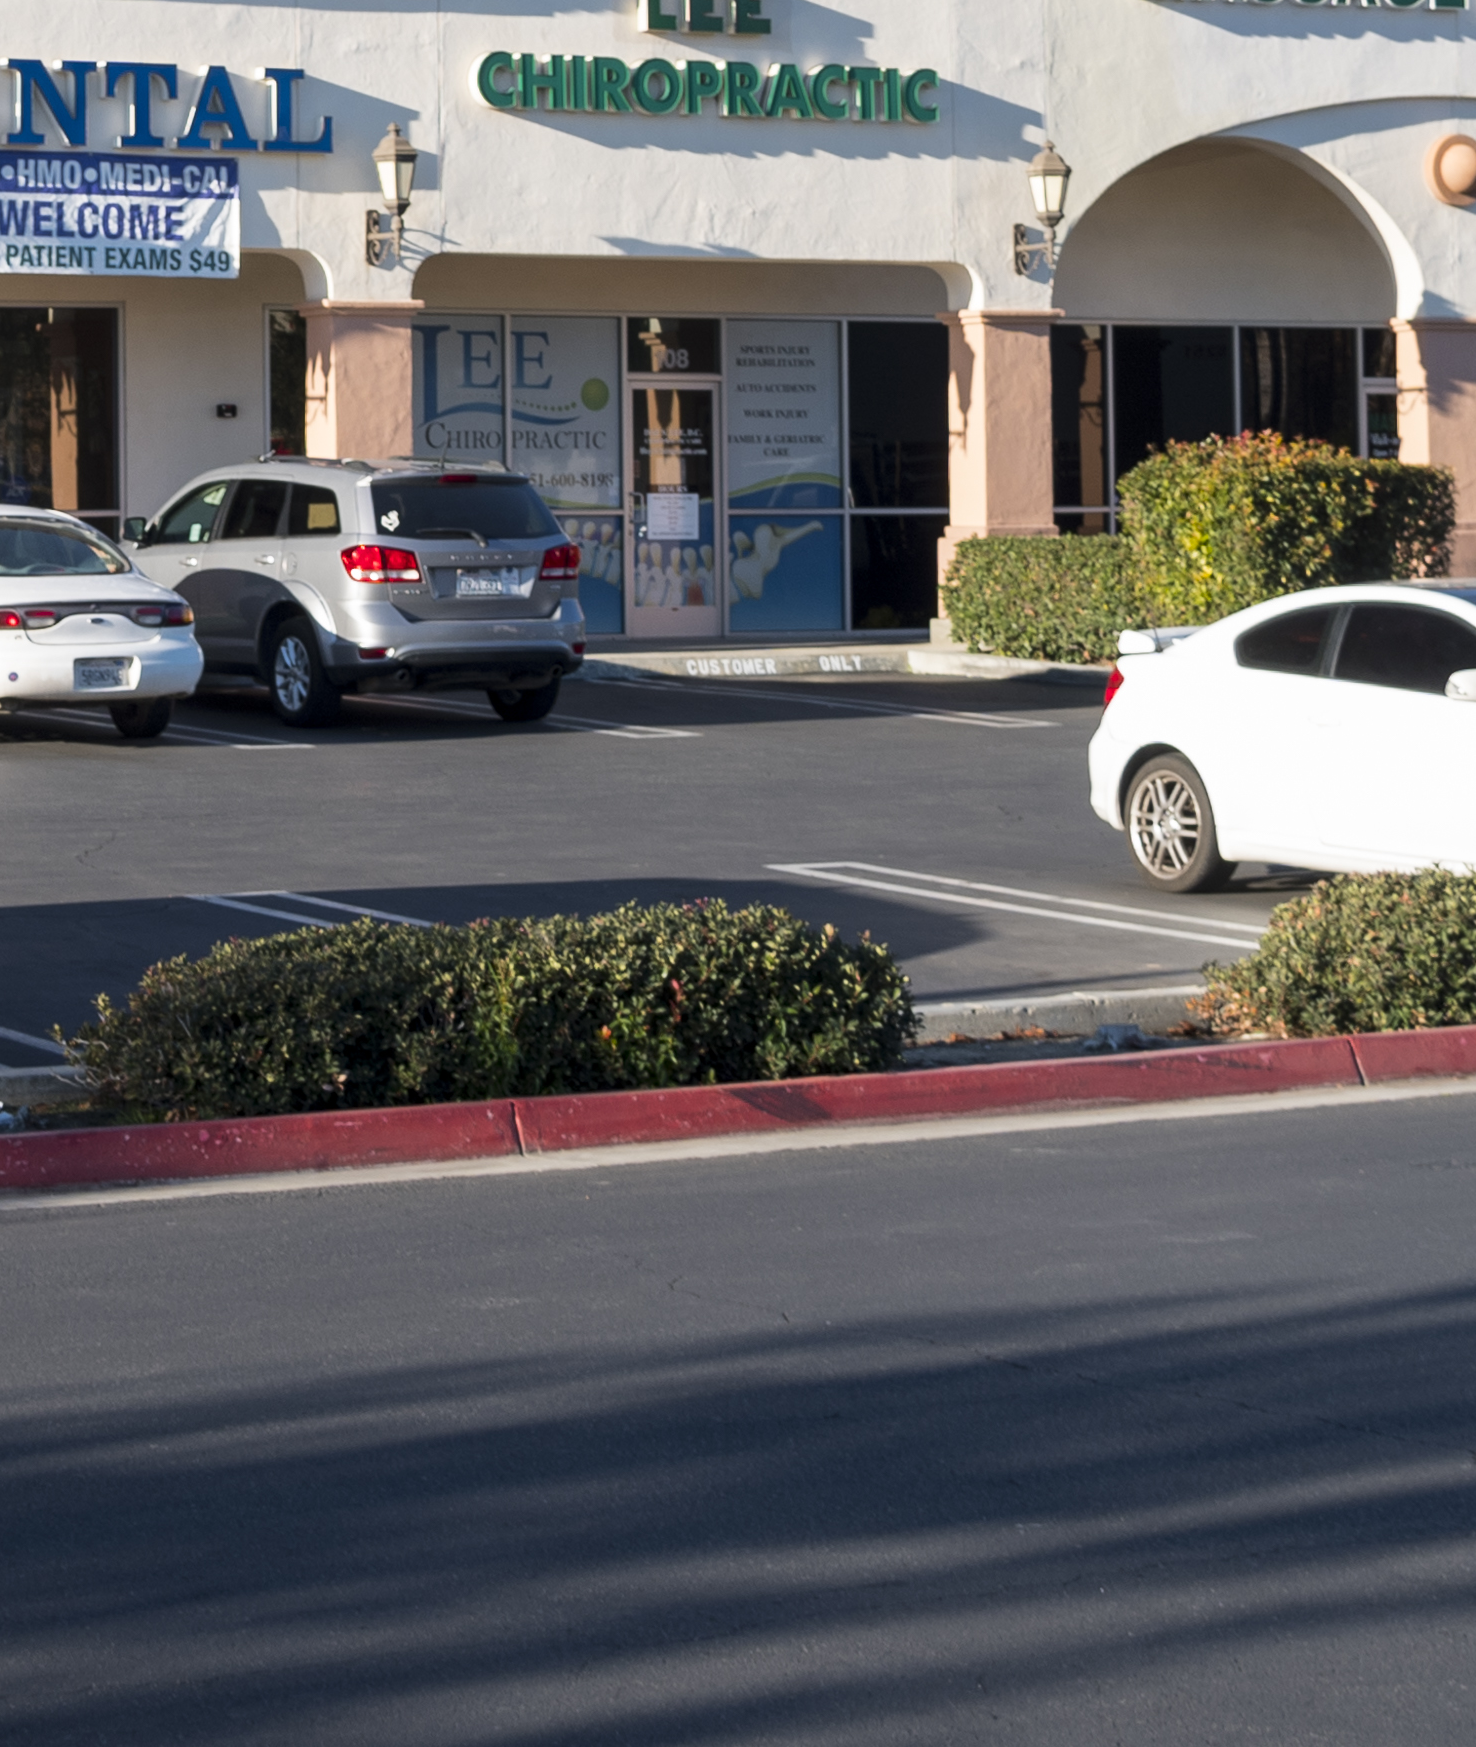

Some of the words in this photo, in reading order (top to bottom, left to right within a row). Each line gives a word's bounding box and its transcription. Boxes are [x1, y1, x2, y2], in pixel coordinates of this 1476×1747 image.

[468, 51, 941, 124] CHIROPRACTIC
[4, 244, 97, 272] PATIENT
[104, 247, 183, 274] EXAMS
[189, 251, 232, 275] $49
[655, 348, 689, 369] 108
[735, 357, 816, 368] REHABILITATION
[412, 324, 553, 424] LEE
[425, 422, 607, 451] CHIROPRACTIC
